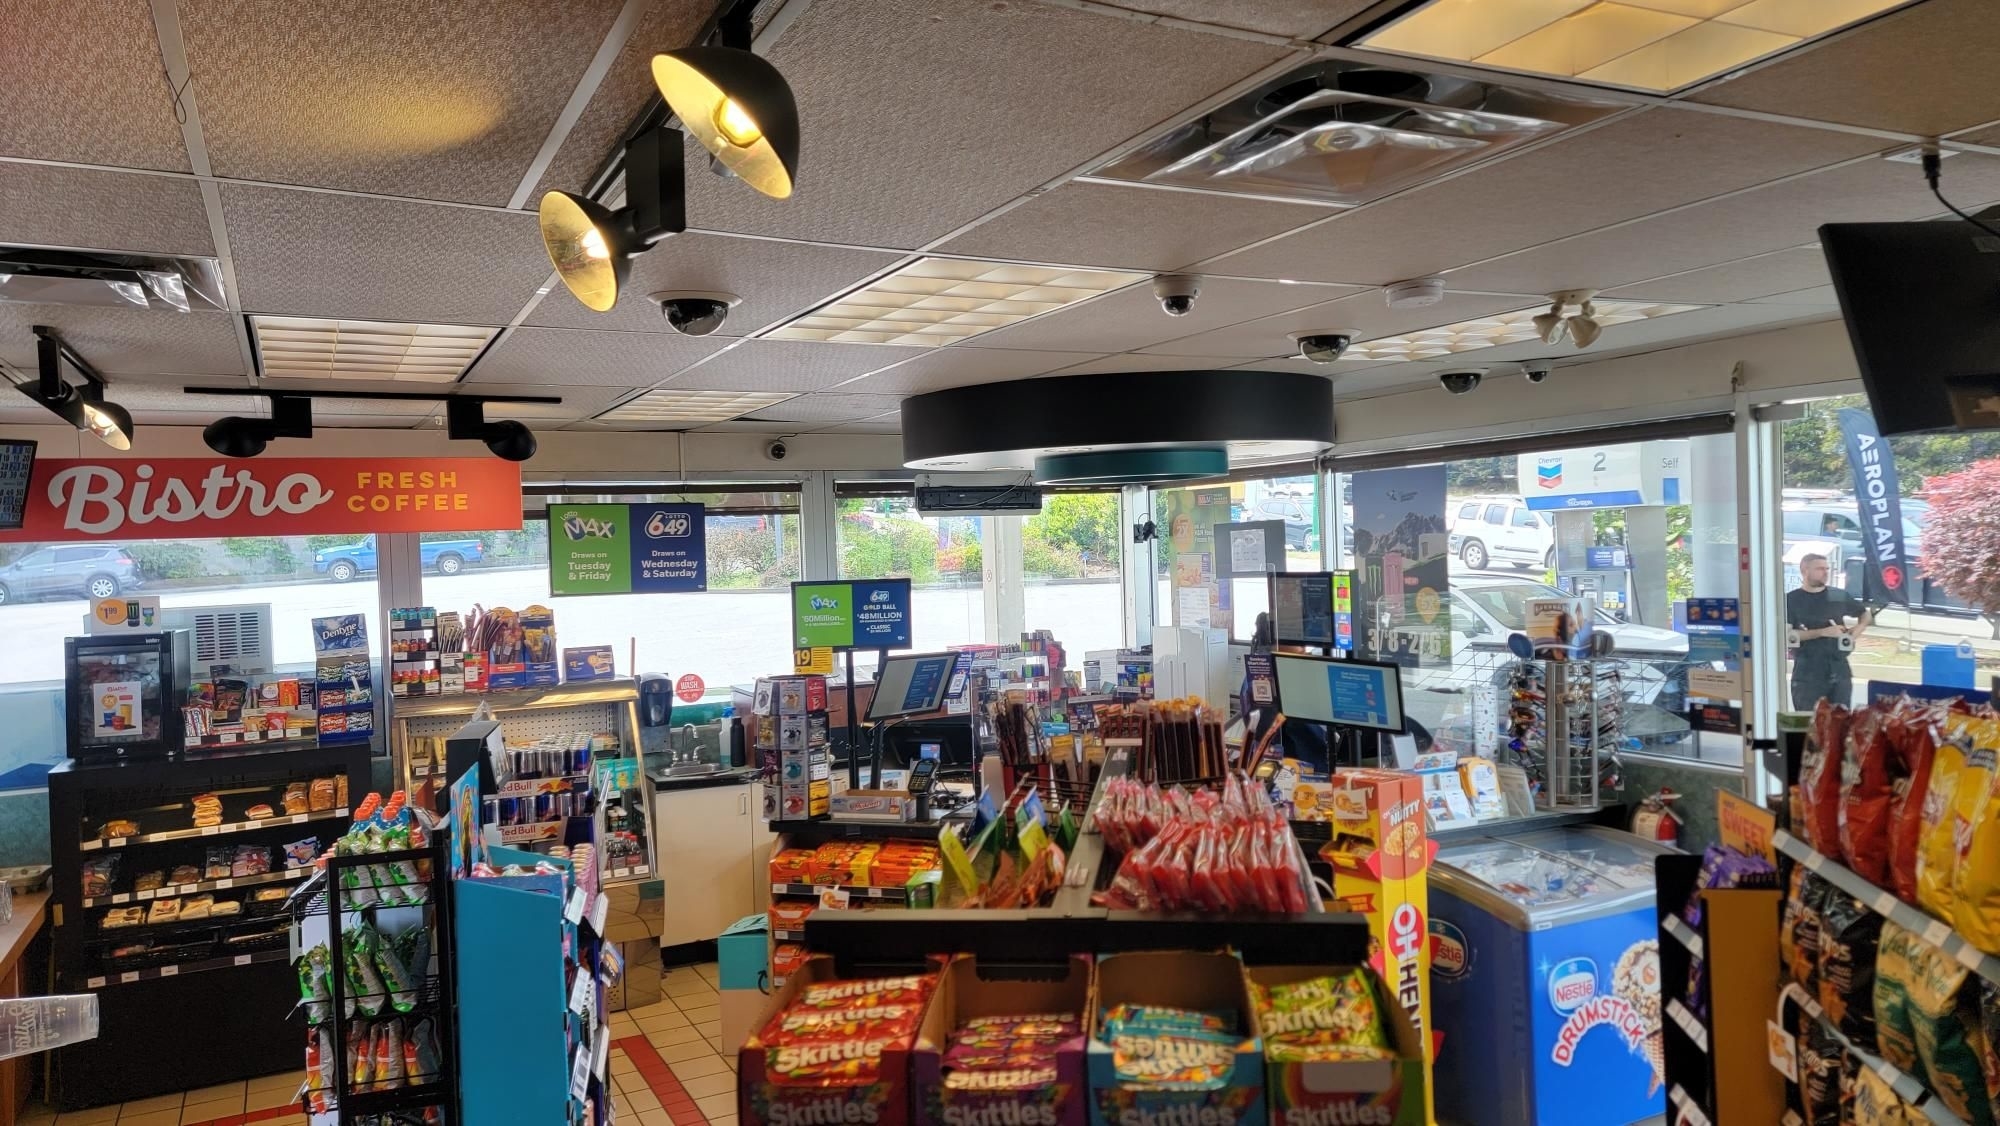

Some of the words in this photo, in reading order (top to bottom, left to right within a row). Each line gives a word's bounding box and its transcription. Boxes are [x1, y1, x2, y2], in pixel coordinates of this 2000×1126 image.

[1538, 456, 1562, 464] Chevron
[1593, 452, 1606, 471] 2
[1662, 457, 1679, 469] Self
[358, 472, 457, 489] FRESH
[48, 464, 334, 534] Bistro
[347, 494, 469, 512] COFFEE
[1857, 433, 1897, 561] AEROPLAN
[563, 517, 613, 540] MAX
[568, 562, 611, 571] Tuesday
[641, 559, 698, 570] Wednesday
[643, 569, 651, 578] &
[653, 568, 697, 579] Saturday
[568, 572, 576, 580] &
[579, 571, 612, 582] Friday
[322, 622, 357, 640] Dentyne
[795, 650, 810, 665] 19
[680, 682, 698, 690] WASH
[500, 783, 513, 792] ed
[514, 781, 532, 791] Bull
[1390, 800, 1420, 827] NUTTY
[518, 825, 536, 834] Bull
[1393, 902, 1419, 963] OH
[804, 974, 921, 1005] Skittles
[774, 1040, 882, 1073] Skittle
[767, 1098, 880, 1125] Skittles
[943, 1100, 1057, 1126] Skittles
[1118, 1102, 1236, 1126] Skittles
[1285, 1100, 1393, 1126] Skittles
